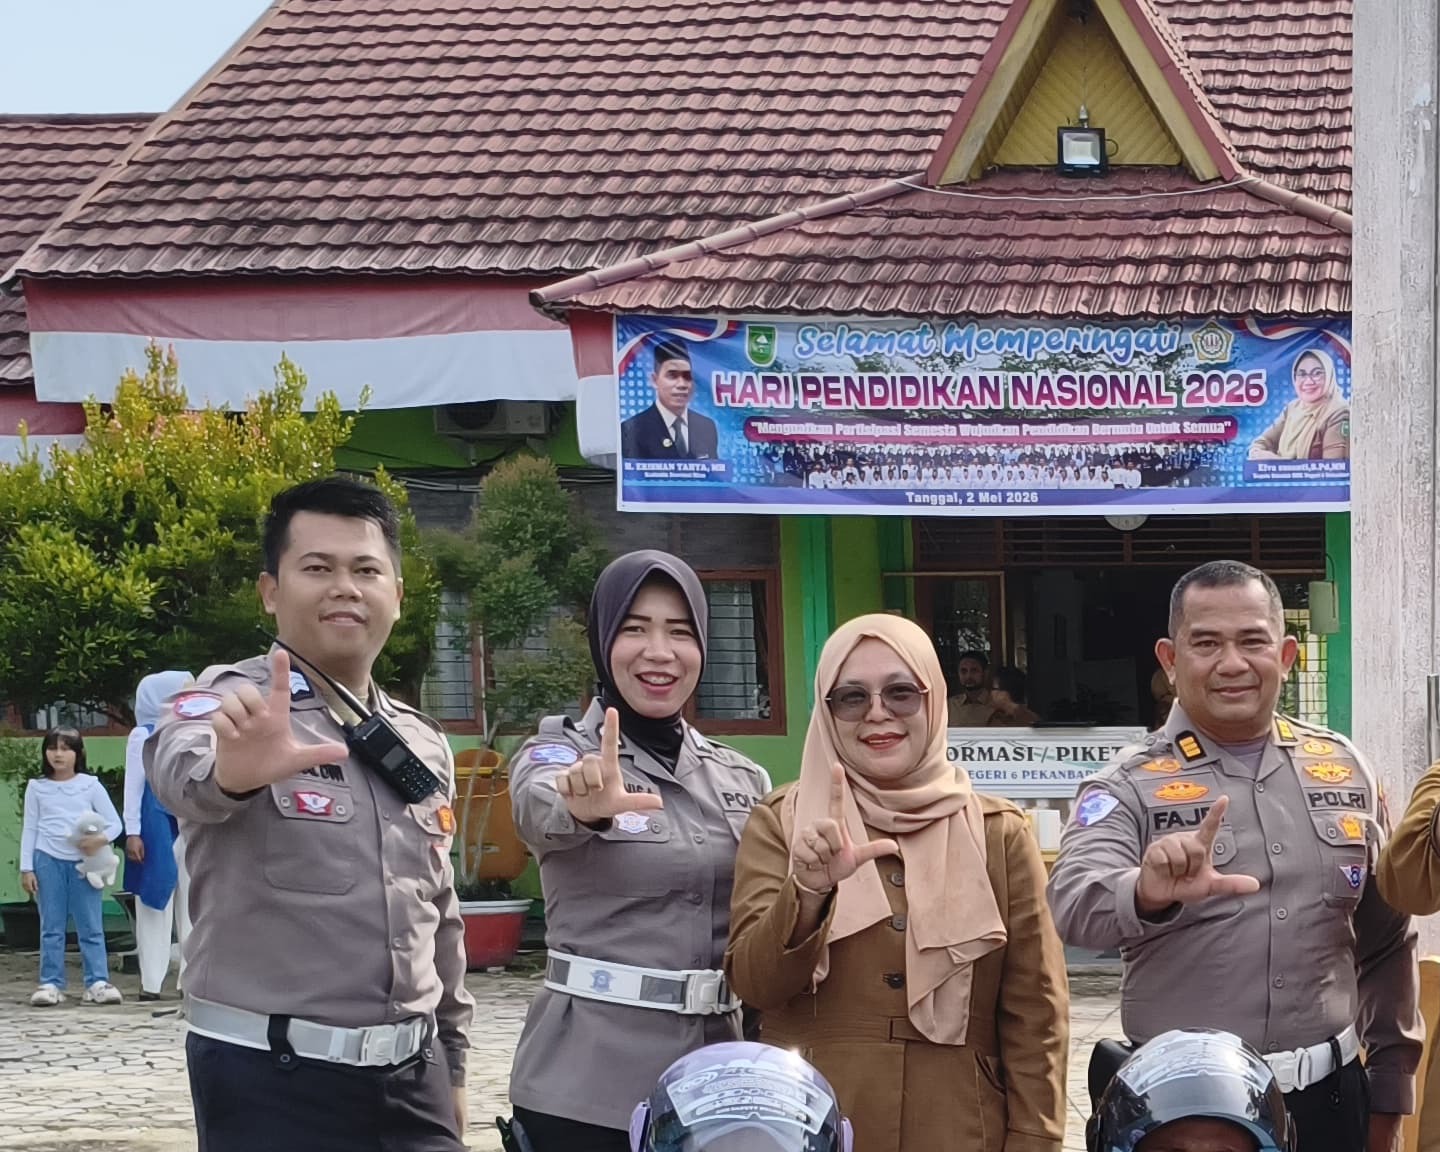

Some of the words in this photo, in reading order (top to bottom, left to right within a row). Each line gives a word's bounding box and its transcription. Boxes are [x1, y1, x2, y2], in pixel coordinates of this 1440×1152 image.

[797, 323, 936, 358] Selamat
[942, 323, 1180, 363] Memperingati
[715, 375, 791, 405] HARI
[802, 375, 999, 406] PENDIDIKAN
[1012, 375, 1174, 406] NASIONAL
[1186, 374, 1265, 404] 2026
[905, 492, 962, 505] Tanggal,
[966, 492, 975, 503] 2
[979, 492, 1002, 503] Mei
[1006, 492, 1039, 503] 2026
[946, 746, 1034, 763] ORMASI
[968, 770, 1007, 780] EGERI
[1011, 772, 1018, 780] 6
[1022, 769, 1099, 780] PEKANBA
[1308, 791, 1366, 809] POLRI
